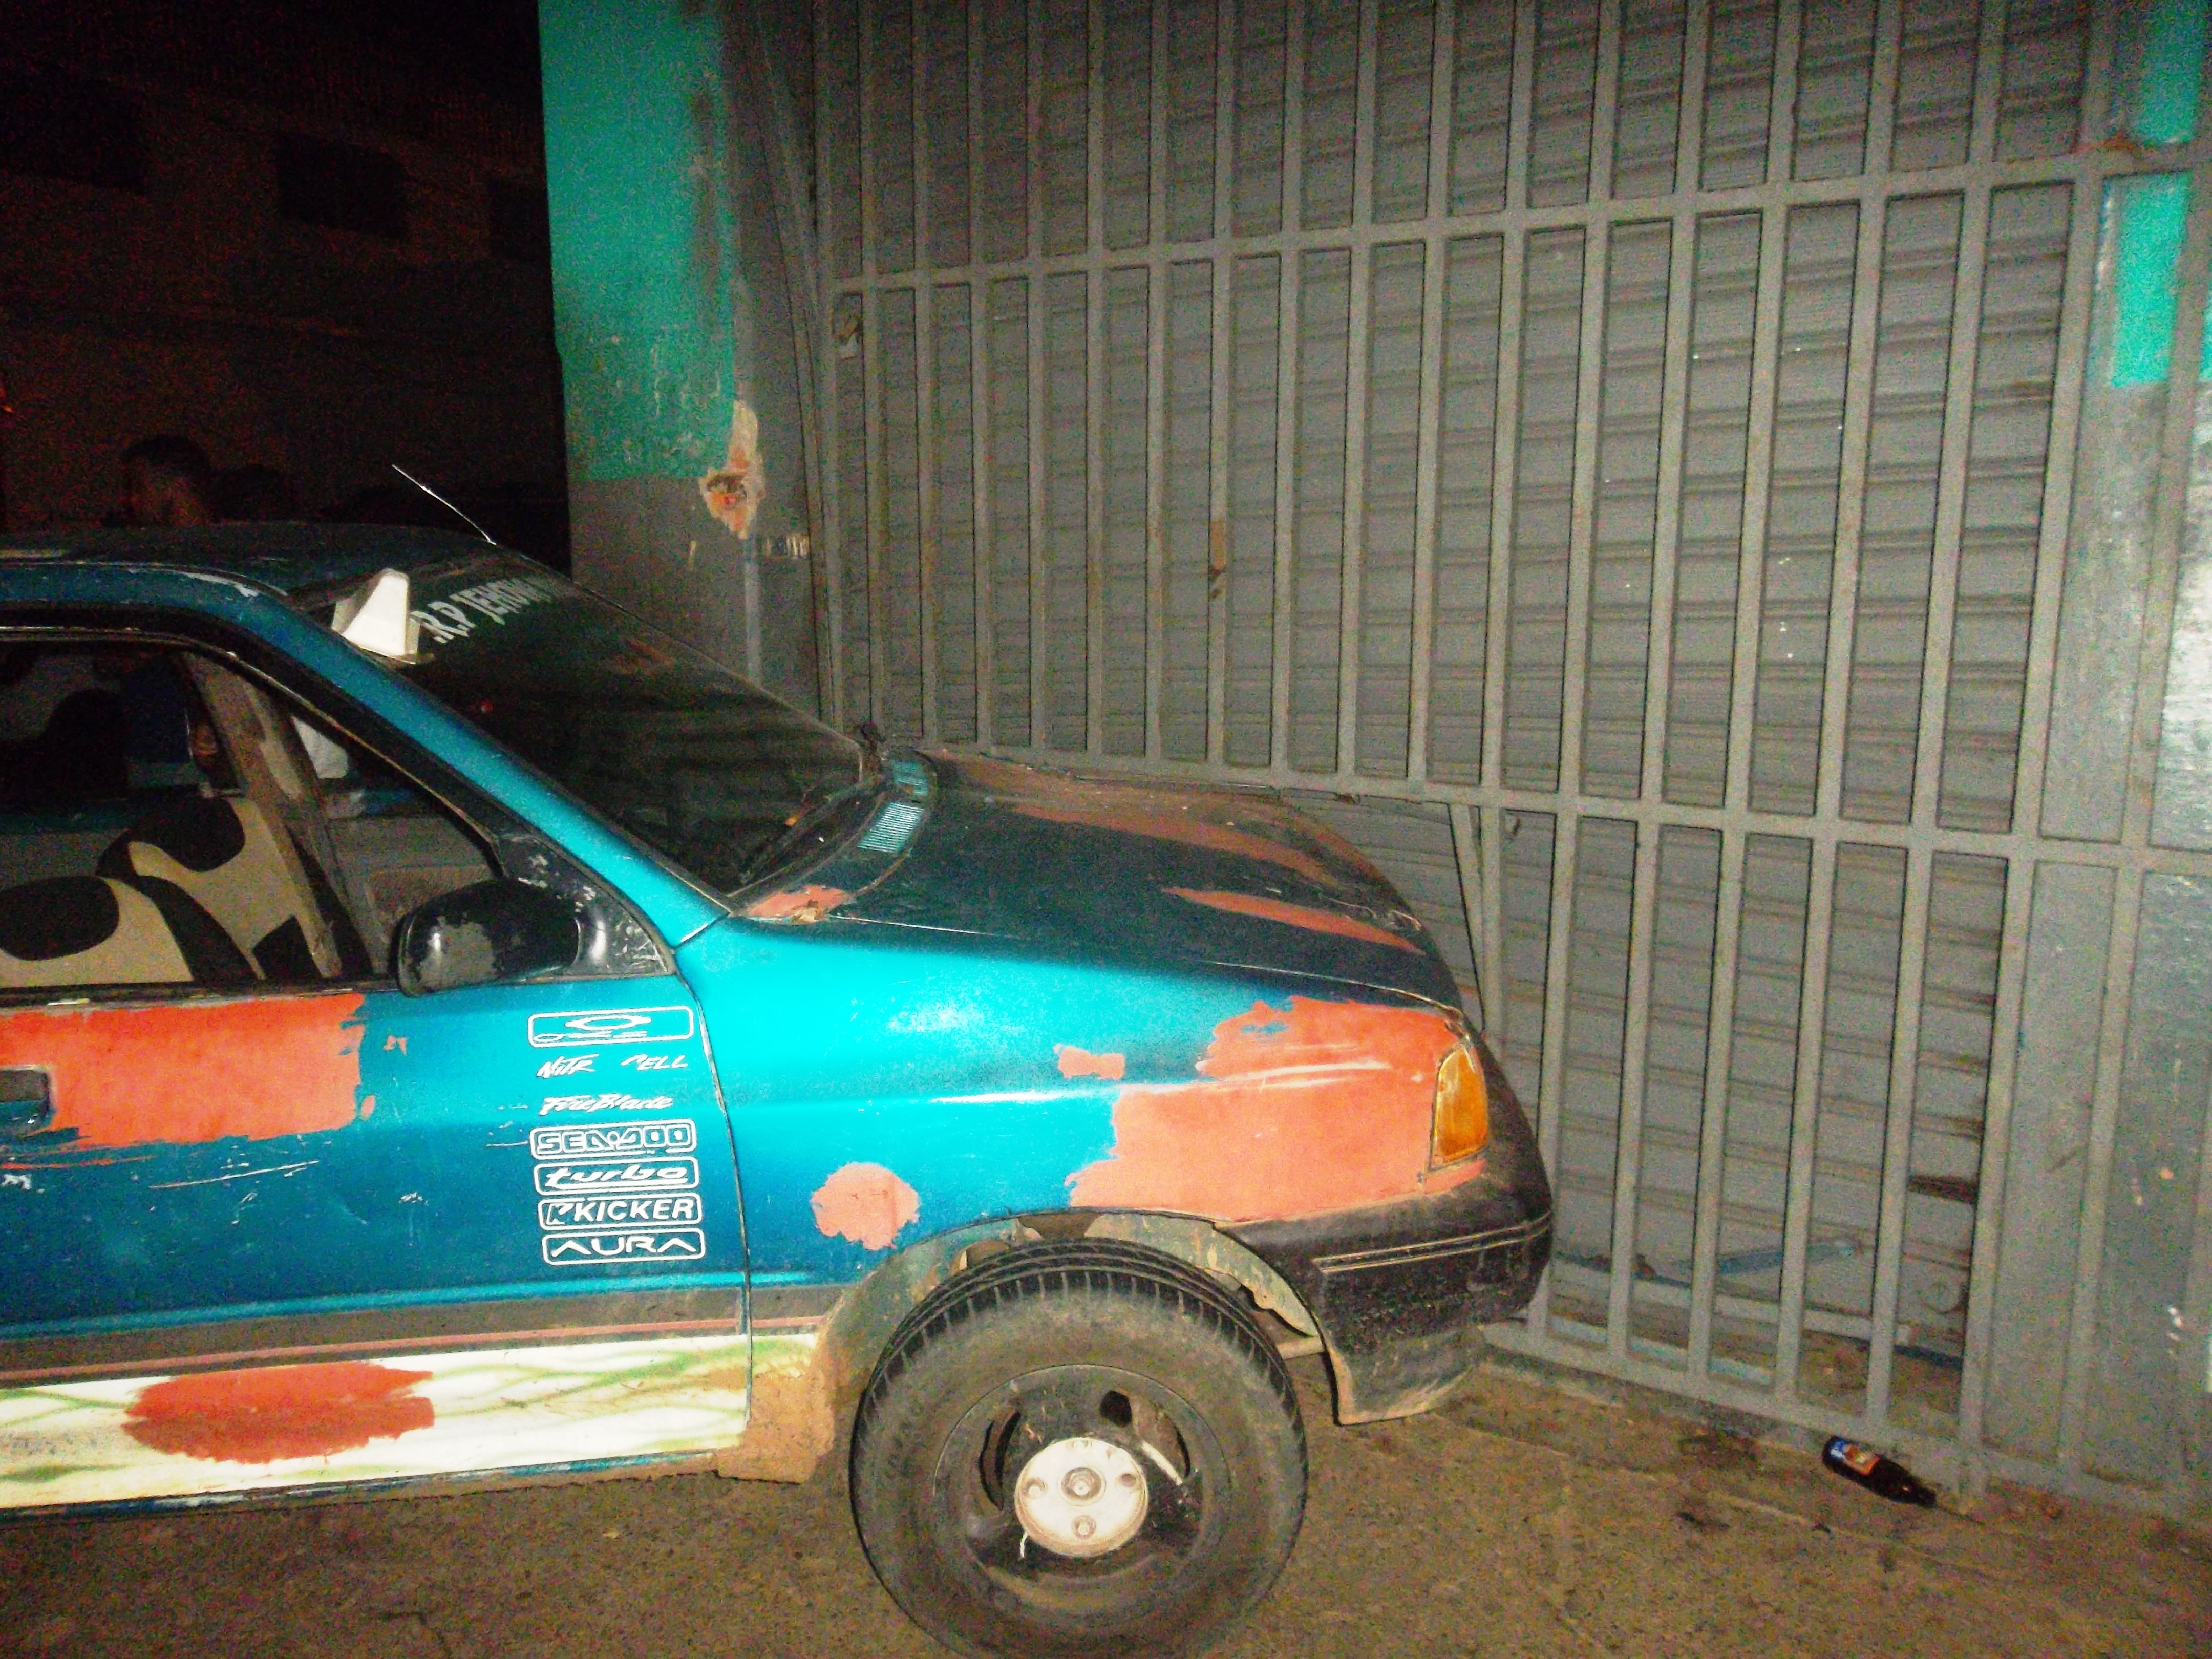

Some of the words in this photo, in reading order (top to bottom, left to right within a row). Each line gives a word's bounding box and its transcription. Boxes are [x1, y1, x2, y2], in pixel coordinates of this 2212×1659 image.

[545, 1165, 689, 1189] turbo
[573, 1199, 693, 1222] KICKER
[550, 1236, 697, 1258] AURA
